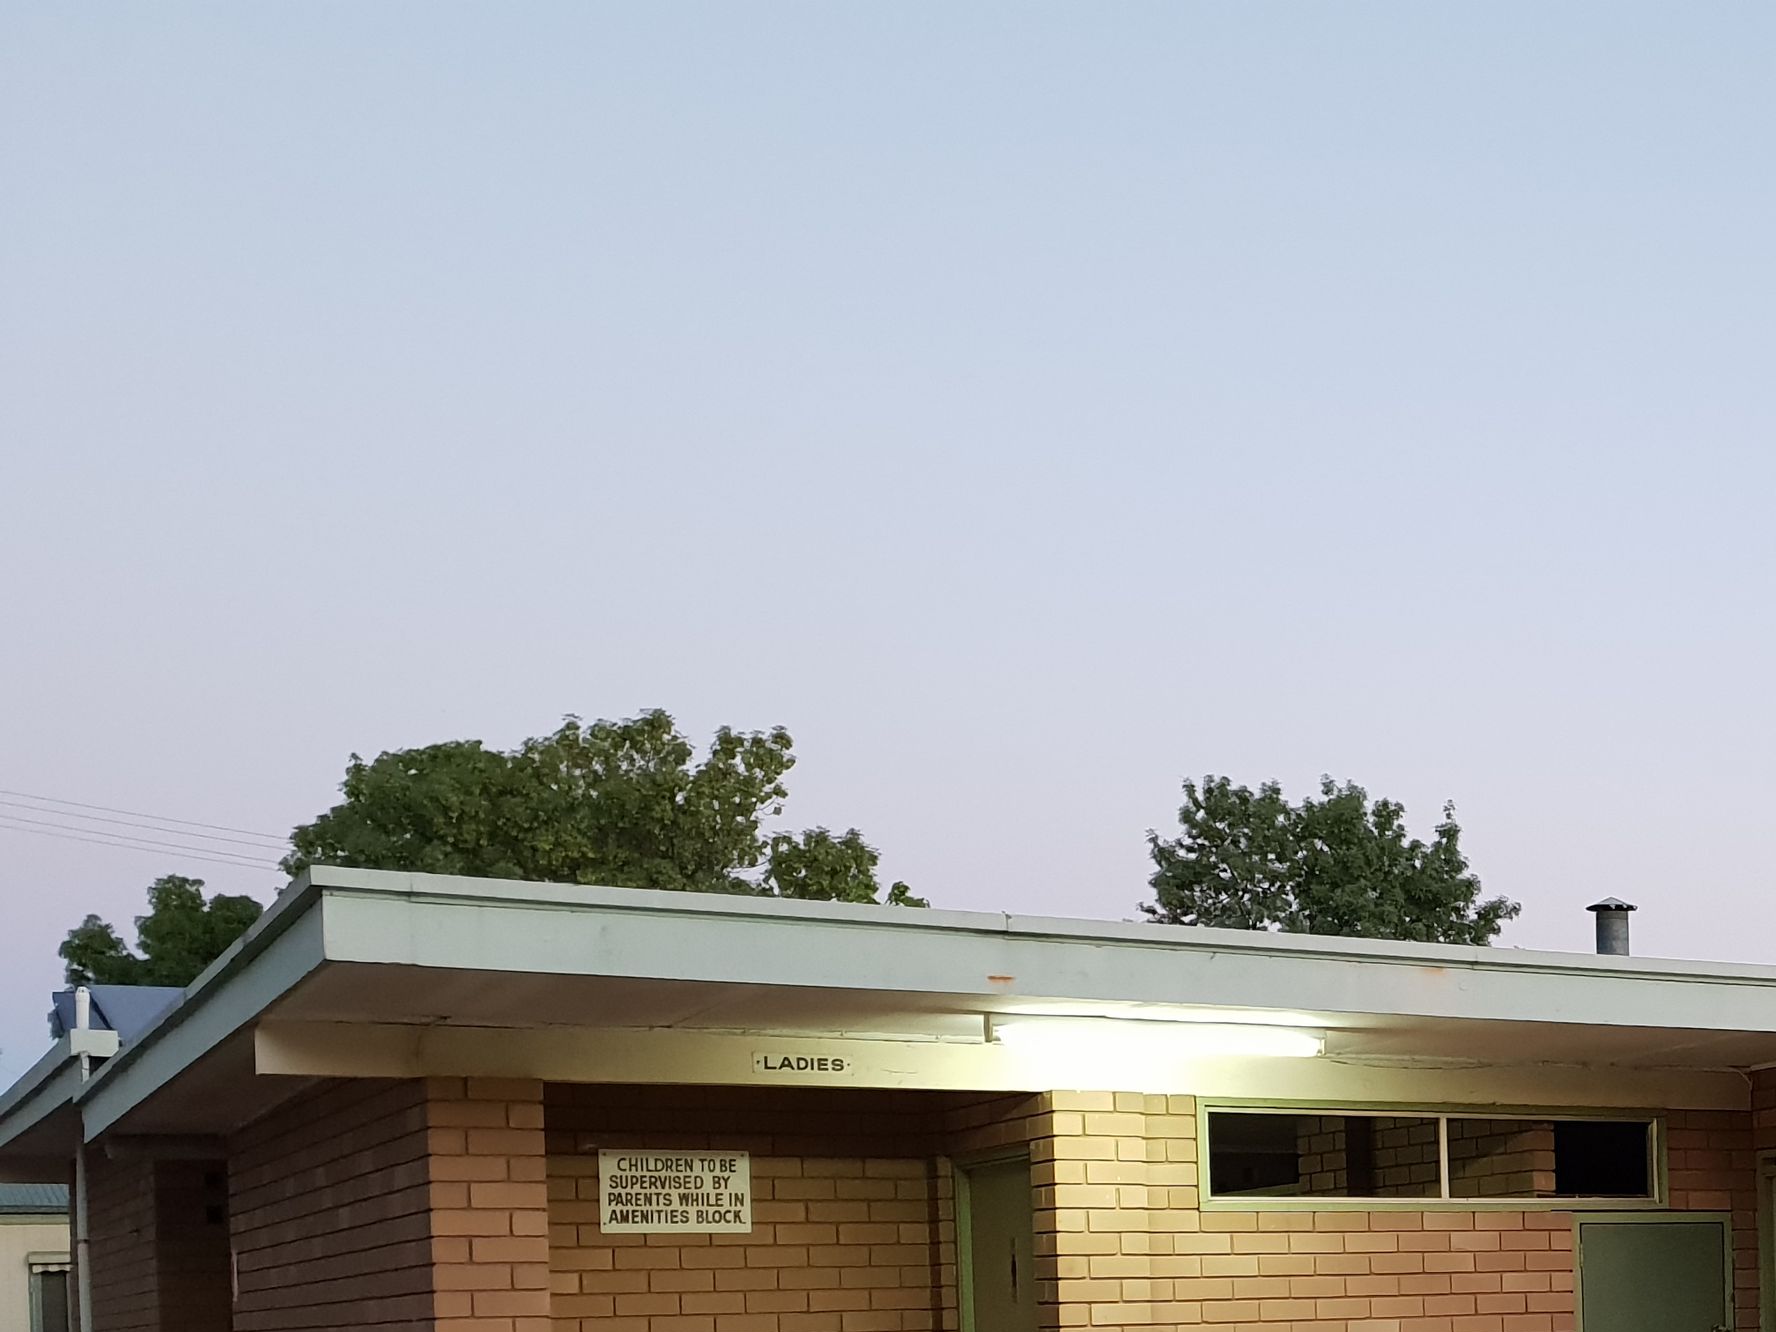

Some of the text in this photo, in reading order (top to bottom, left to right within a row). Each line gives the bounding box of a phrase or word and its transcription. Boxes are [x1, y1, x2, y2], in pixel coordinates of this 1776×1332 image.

[763, 1056, 845, 1072] LADIES
[617, 1157, 737, 1173] CHILDREN TO BE
[609, 1175, 731, 1190] SUPERVISED BY
[608, 1192, 744, 1207] PARENTS WHILE IN
[608, 1209, 690, 1225] AMENITIES
